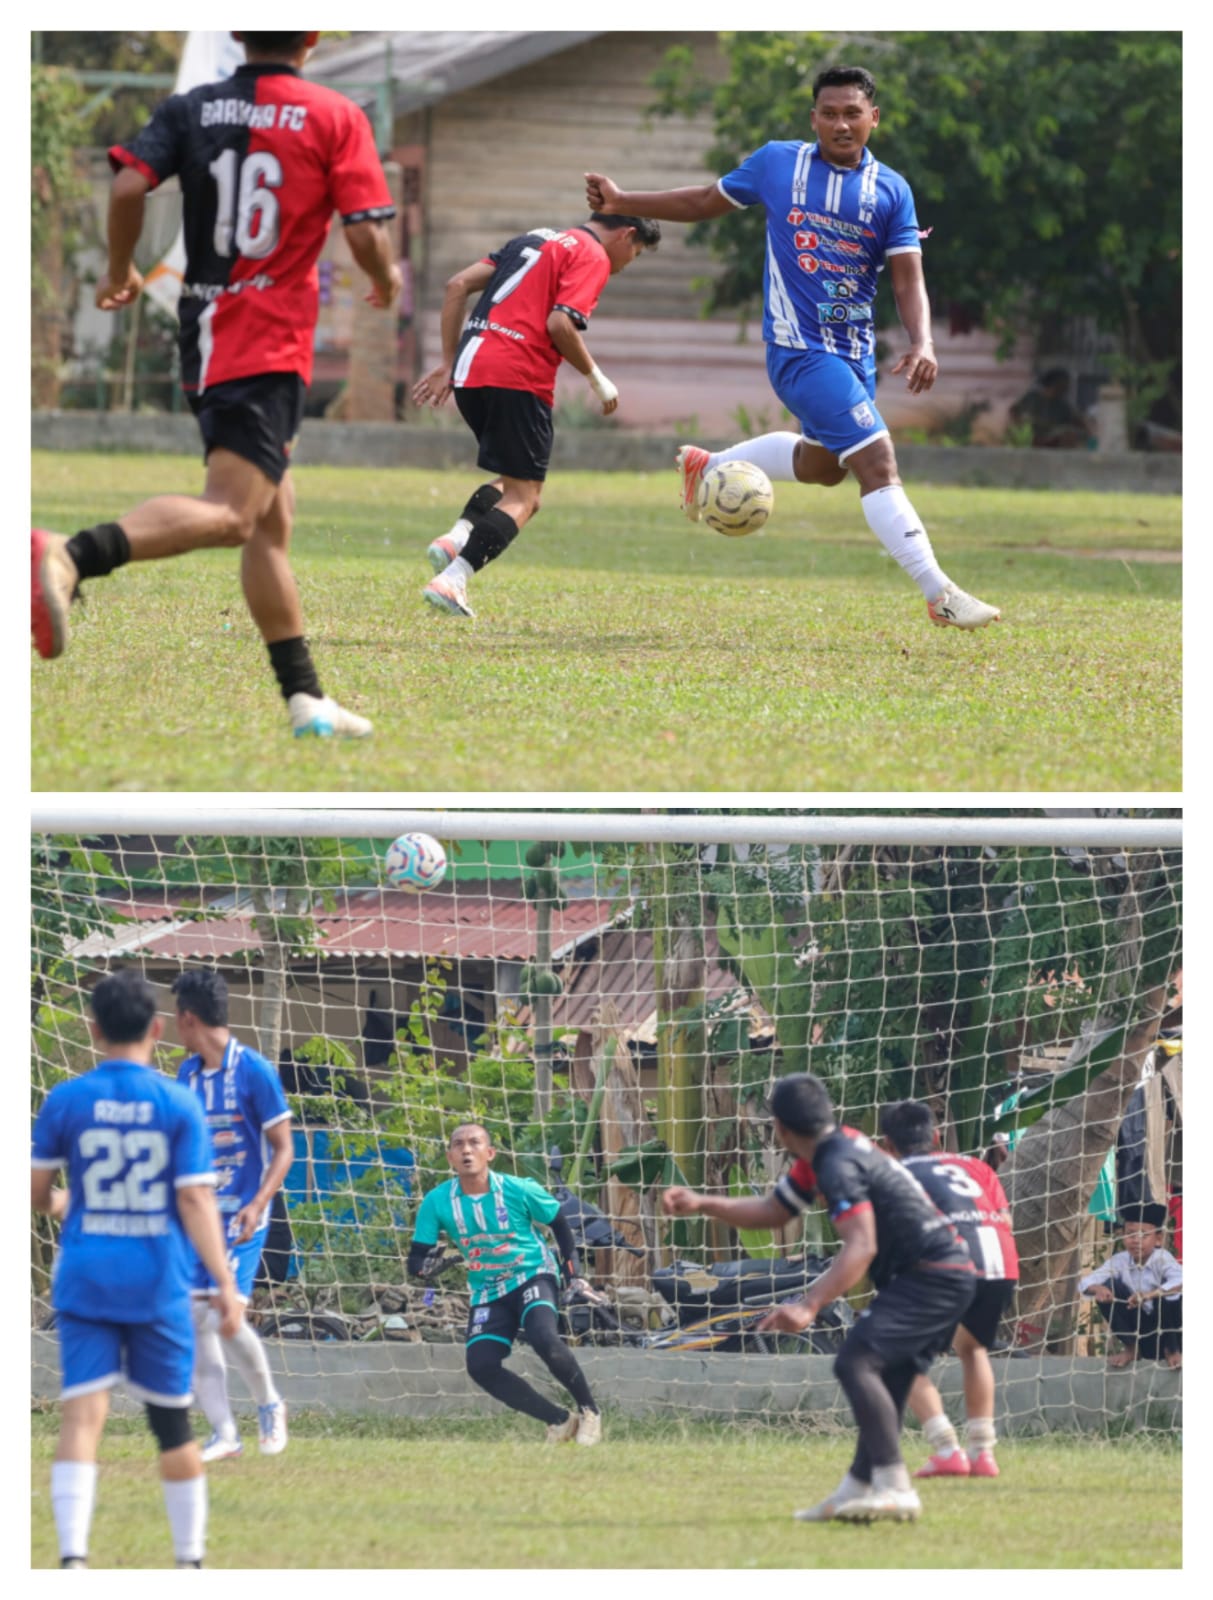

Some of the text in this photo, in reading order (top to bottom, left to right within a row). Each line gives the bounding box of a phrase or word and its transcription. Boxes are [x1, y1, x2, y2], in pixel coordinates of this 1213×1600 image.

[279, 104, 307, 131] FC
[209, 149, 282, 259] 16
[492, 246, 543, 304] 7
[79, 1130, 169, 1211] 22
[932, 1163, 984, 1197] 3
